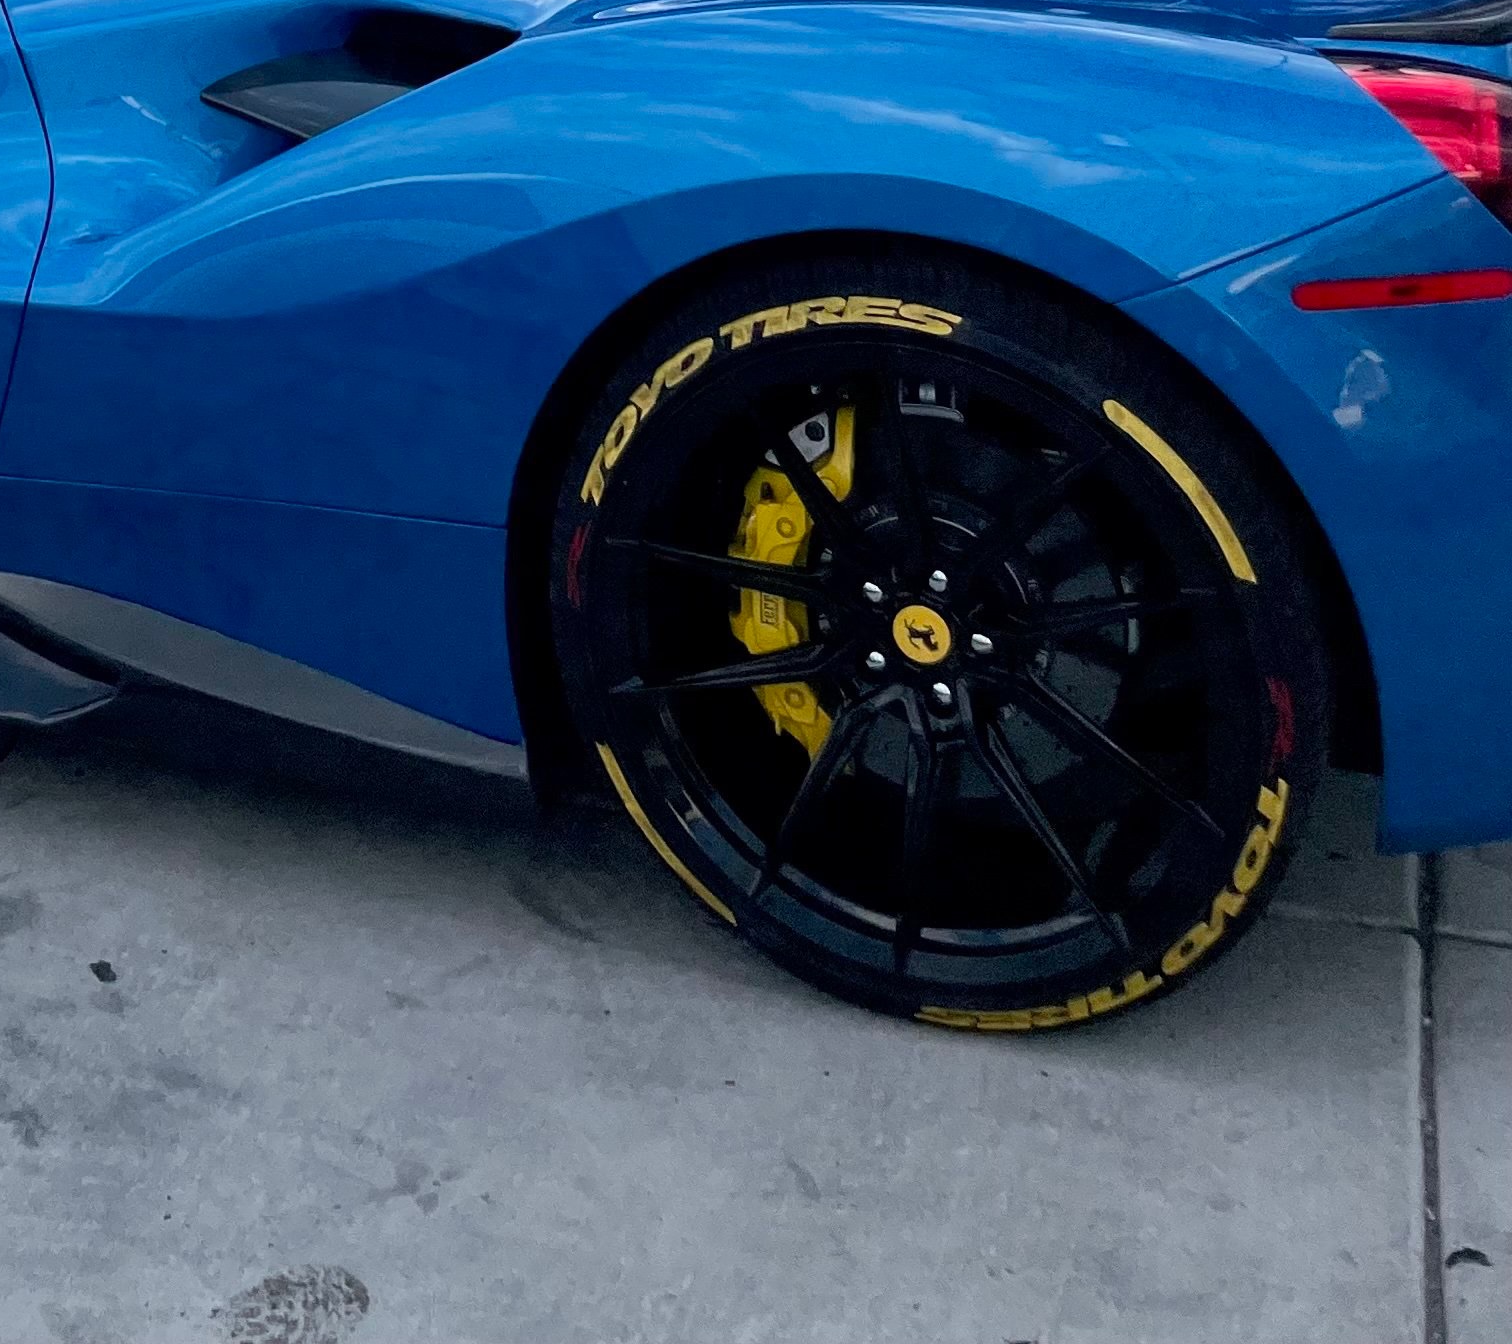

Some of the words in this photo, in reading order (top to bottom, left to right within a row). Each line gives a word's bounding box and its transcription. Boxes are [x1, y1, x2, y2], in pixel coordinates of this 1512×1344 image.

[580, 336, 715, 507] TOYO
[719, 295, 963, 351] TIRES
[1160, 777, 1289, 976] TOYO
